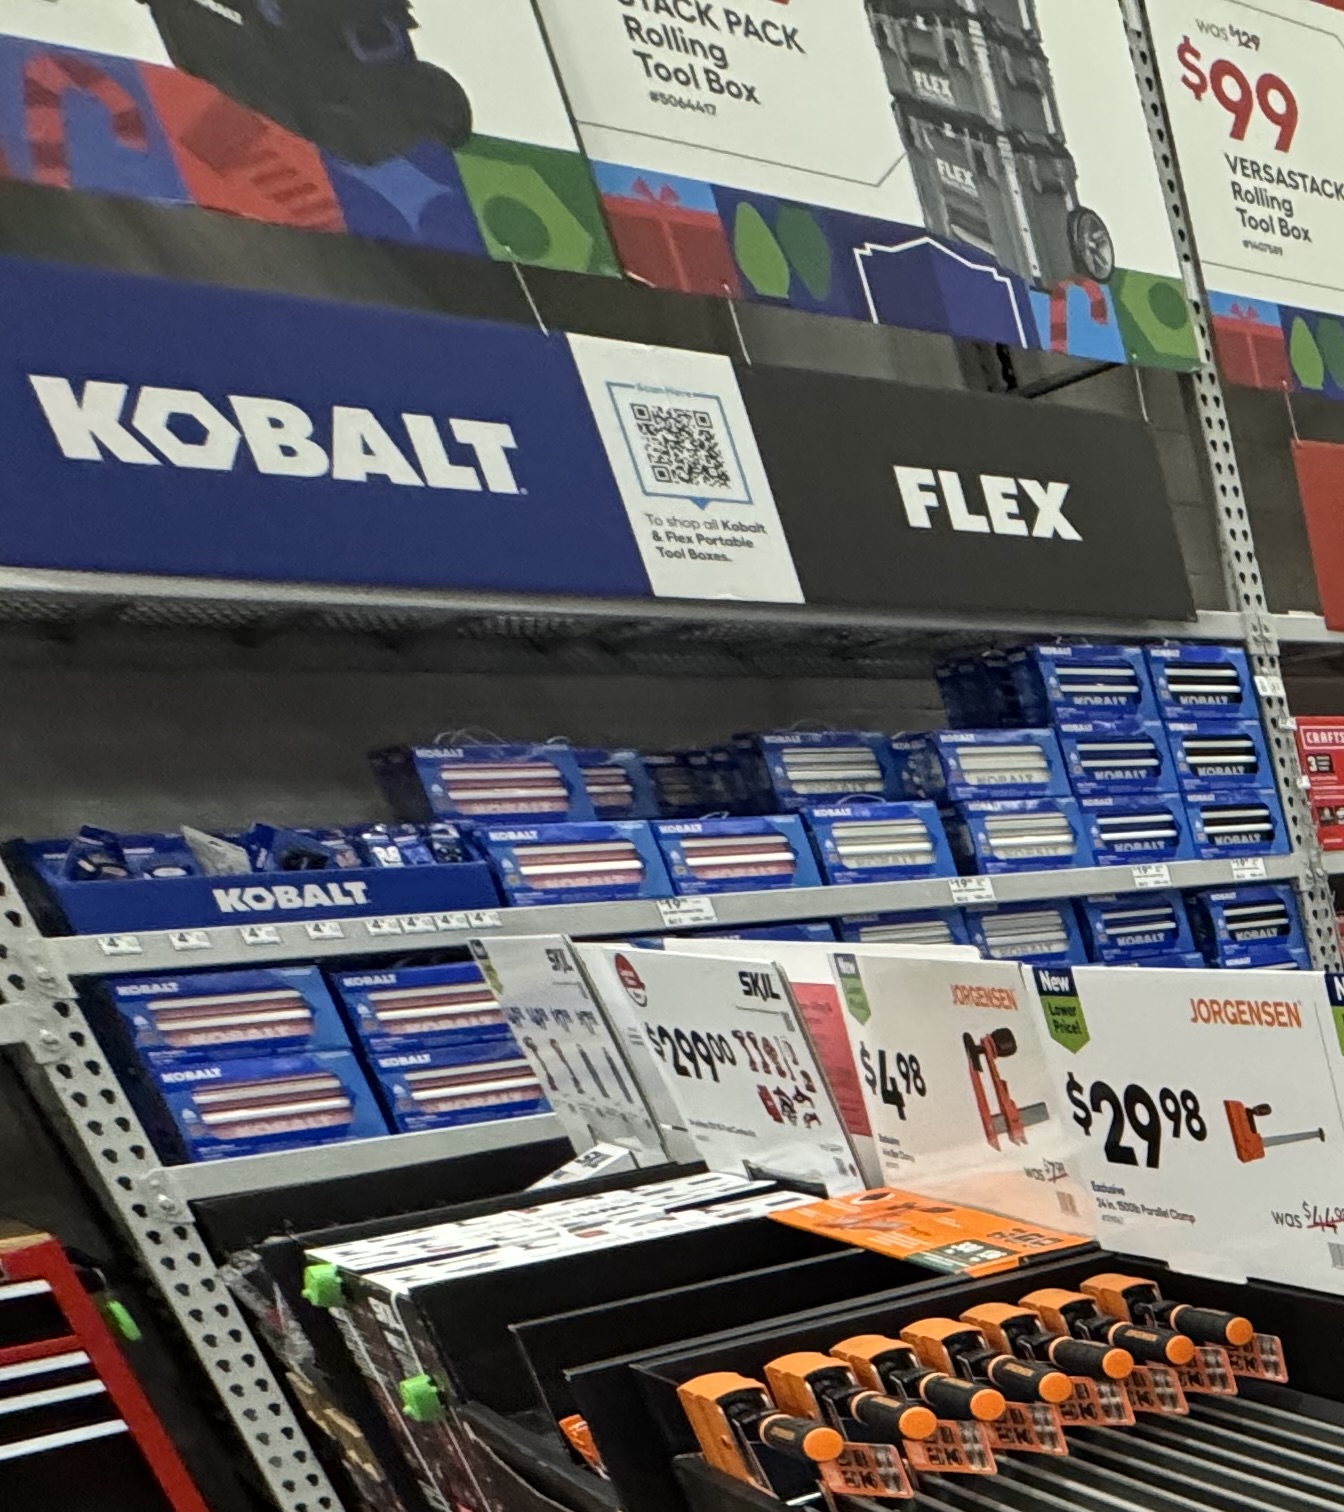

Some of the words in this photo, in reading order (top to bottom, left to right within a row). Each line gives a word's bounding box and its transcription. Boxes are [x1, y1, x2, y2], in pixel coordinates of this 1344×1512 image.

[622, 14, 729, 69] Rolling
[1196, 18, 1230, 43] was
[633, 49, 701, 90] Tool
[703, 67, 762, 105] Box
[1177, 35, 1298, 153] $99
[936, 157, 975, 186] FLEX
[1231, 181, 1294, 218] Rolling
[1236, 207, 1276, 236] Tool
[1278, 216, 1313, 243] Box
[27, 374, 520, 494] KOBALT
[893, 465, 1083, 542] FLEX
[212, 882, 371, 914] KOBALT
[738, 971, 780, 1001] SKIL
[950, 984, 1019, 1012] JORGENSEN
[1039, 973, 1071, 993] New
[1049, 1003, 1077, 1018] Lower
[1190, 998, 1302, 1028] JORGENSEN
[1053, 1019, 1081, 1035] Price!
[1271, 1211, 1302, 1229] was
